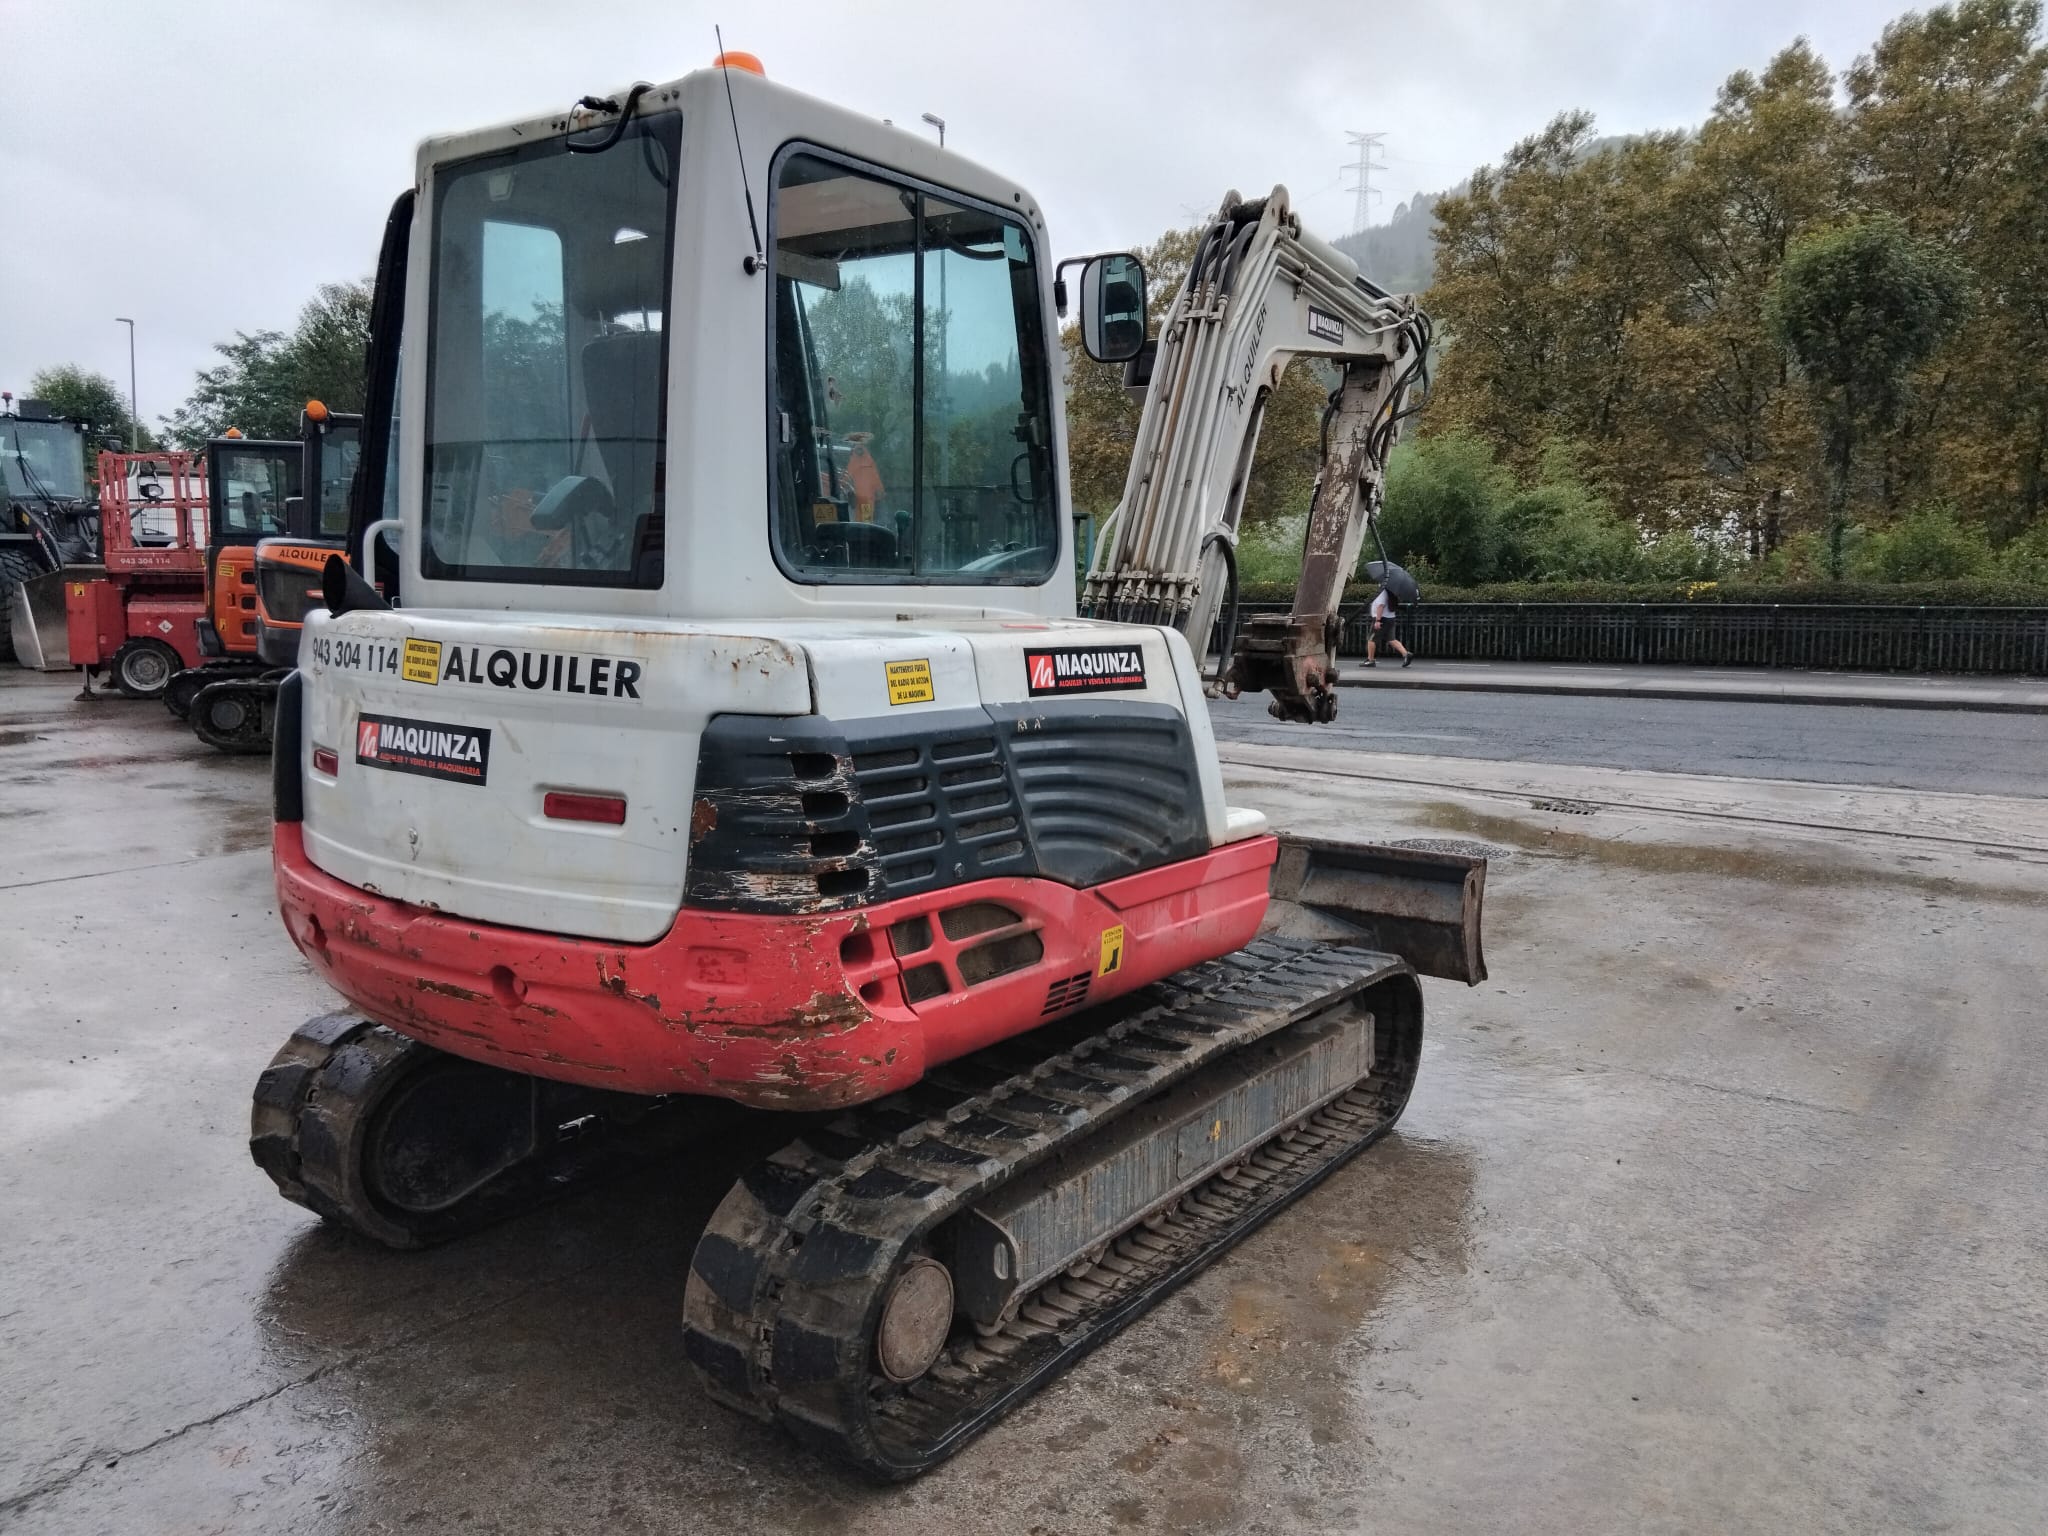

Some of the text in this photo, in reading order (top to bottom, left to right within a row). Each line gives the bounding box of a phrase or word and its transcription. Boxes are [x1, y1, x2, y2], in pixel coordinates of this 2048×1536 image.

[1237, 303, 1267, 415] ALQUILER
[279, 549, 330, 562] ALQUILE
[313, 637, 398, 675] 943 304 114
[443, 646, 641, 699] ALQUILER
[1055, 652, 1142, 676] MAQUINZA
[380, 723, 481, 763] MAQUINZA
